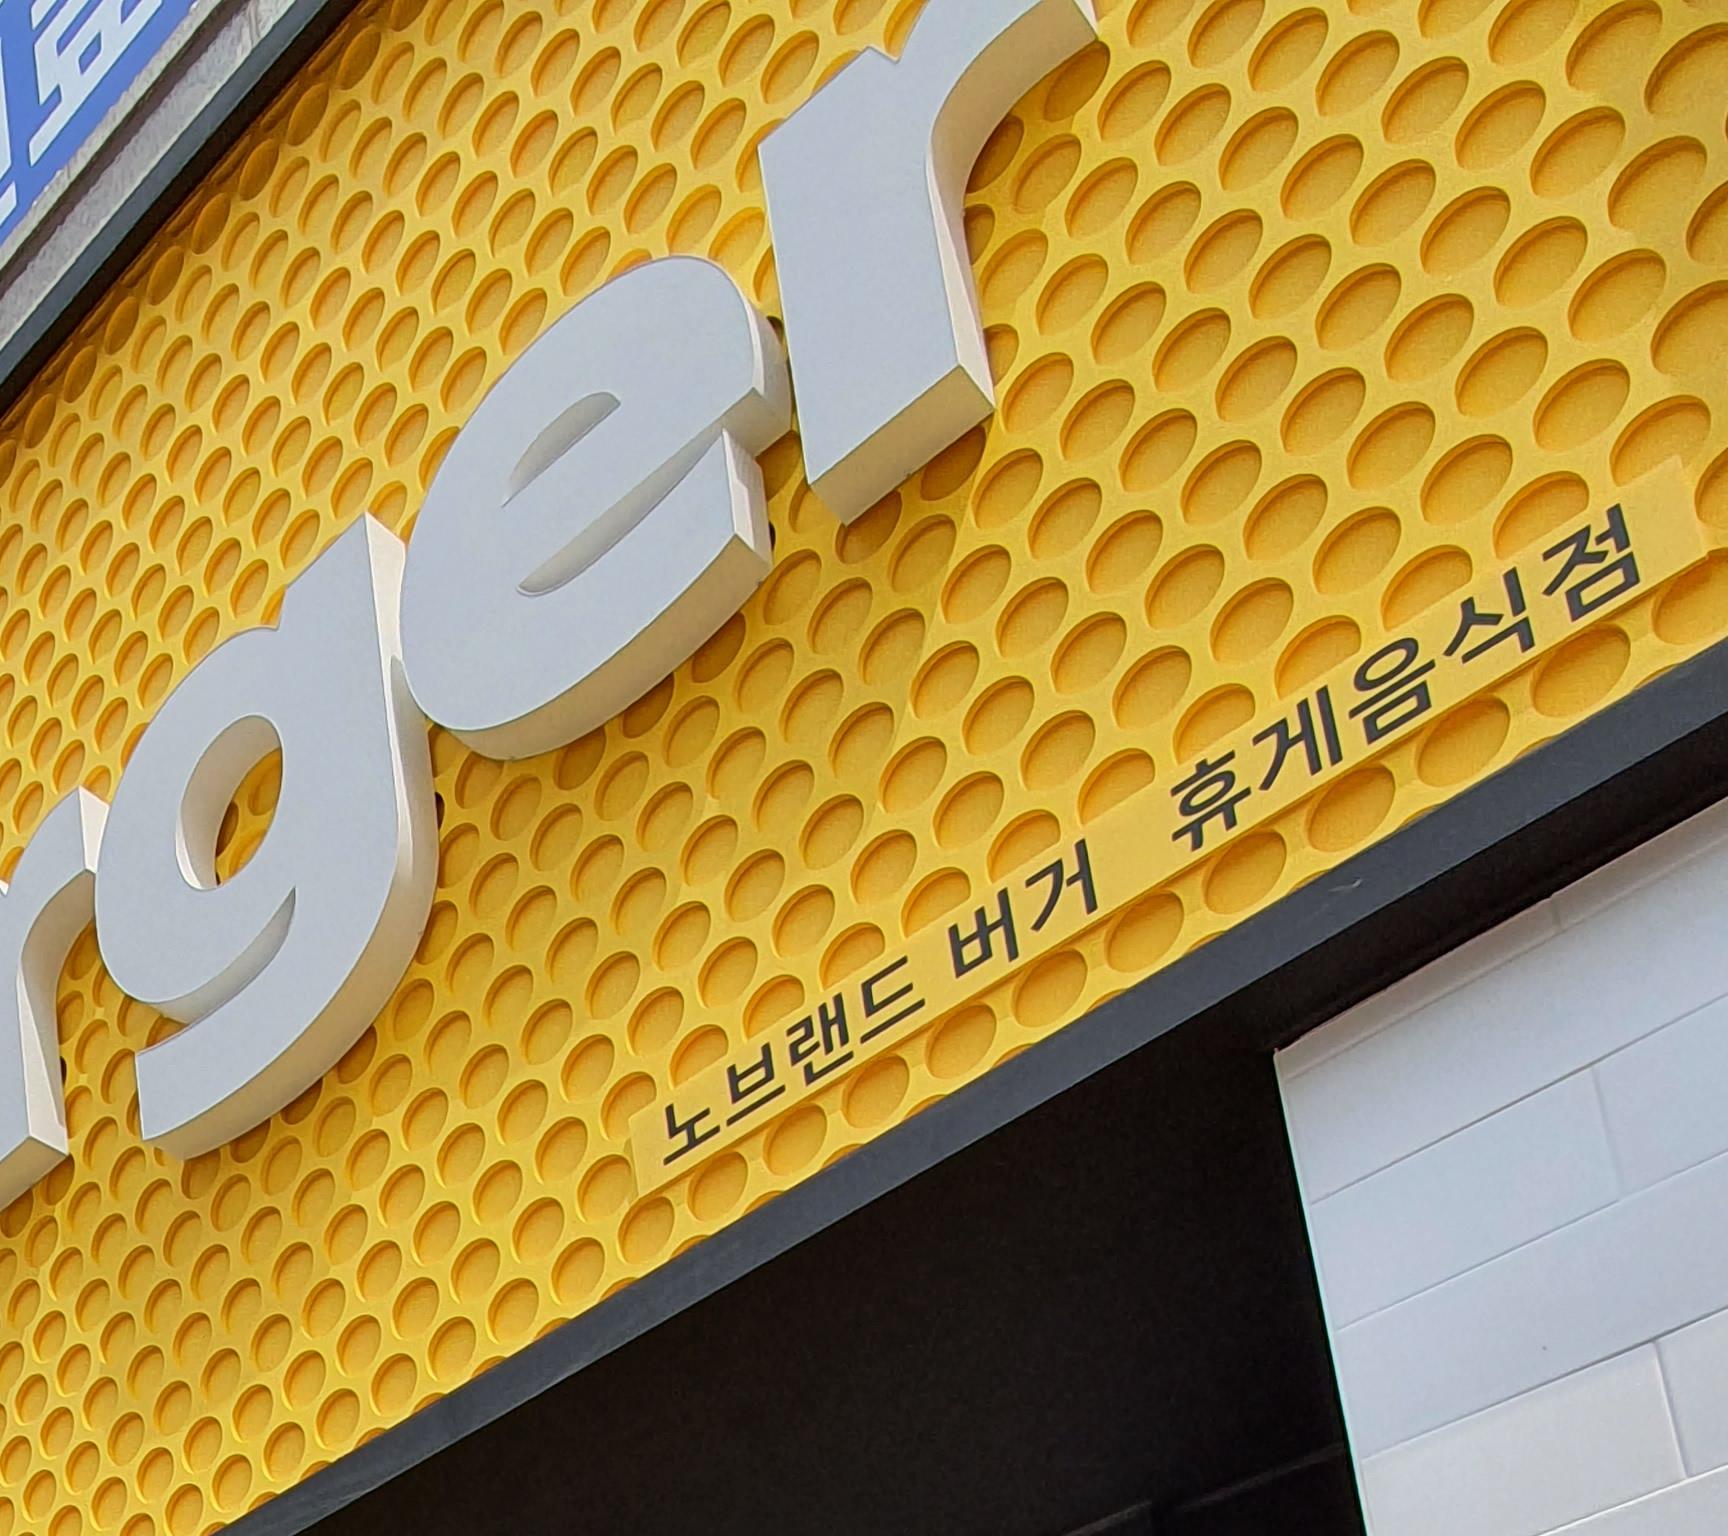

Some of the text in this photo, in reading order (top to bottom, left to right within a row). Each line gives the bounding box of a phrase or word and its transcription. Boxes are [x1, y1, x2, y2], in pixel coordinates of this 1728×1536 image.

[662, 503, 1644, 1166] 노브랜드 버거 휴게음식점
